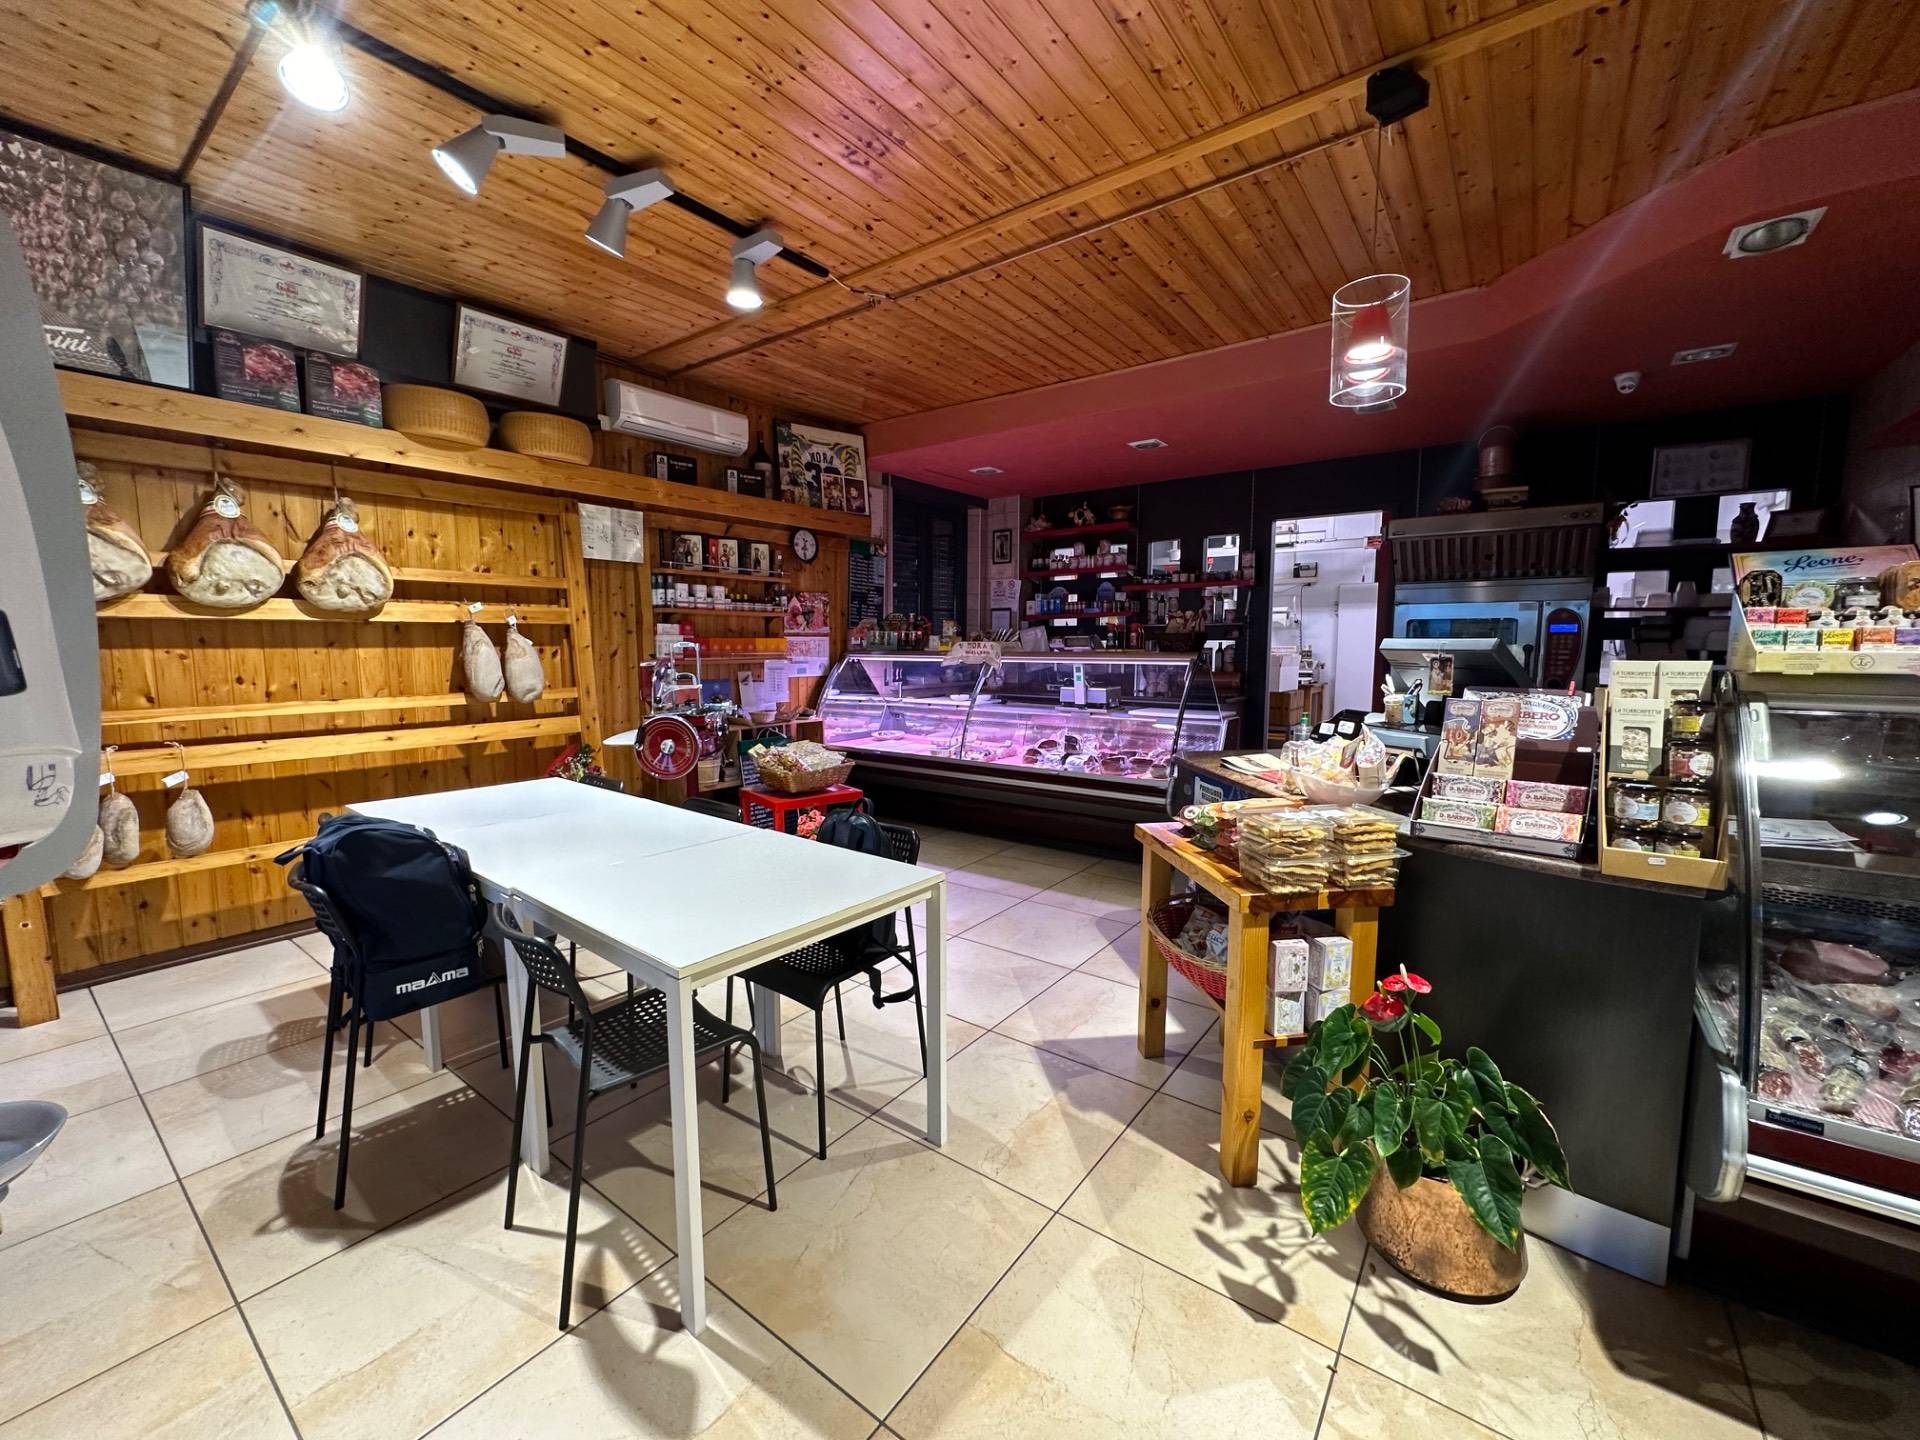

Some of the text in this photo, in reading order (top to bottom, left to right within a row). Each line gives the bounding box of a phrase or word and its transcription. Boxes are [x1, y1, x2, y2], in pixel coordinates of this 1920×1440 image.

[808, 452, 834, 465] MORA
[1783, 554, 1865, 573] Leone
[1456, 786, 1486, 794] BARBERO
[1533, 794, 1565, 802] BARBERO
[1446, 813, 1476, 822] BARBERO
[1524, 821, 1558, 830] BARBERO
